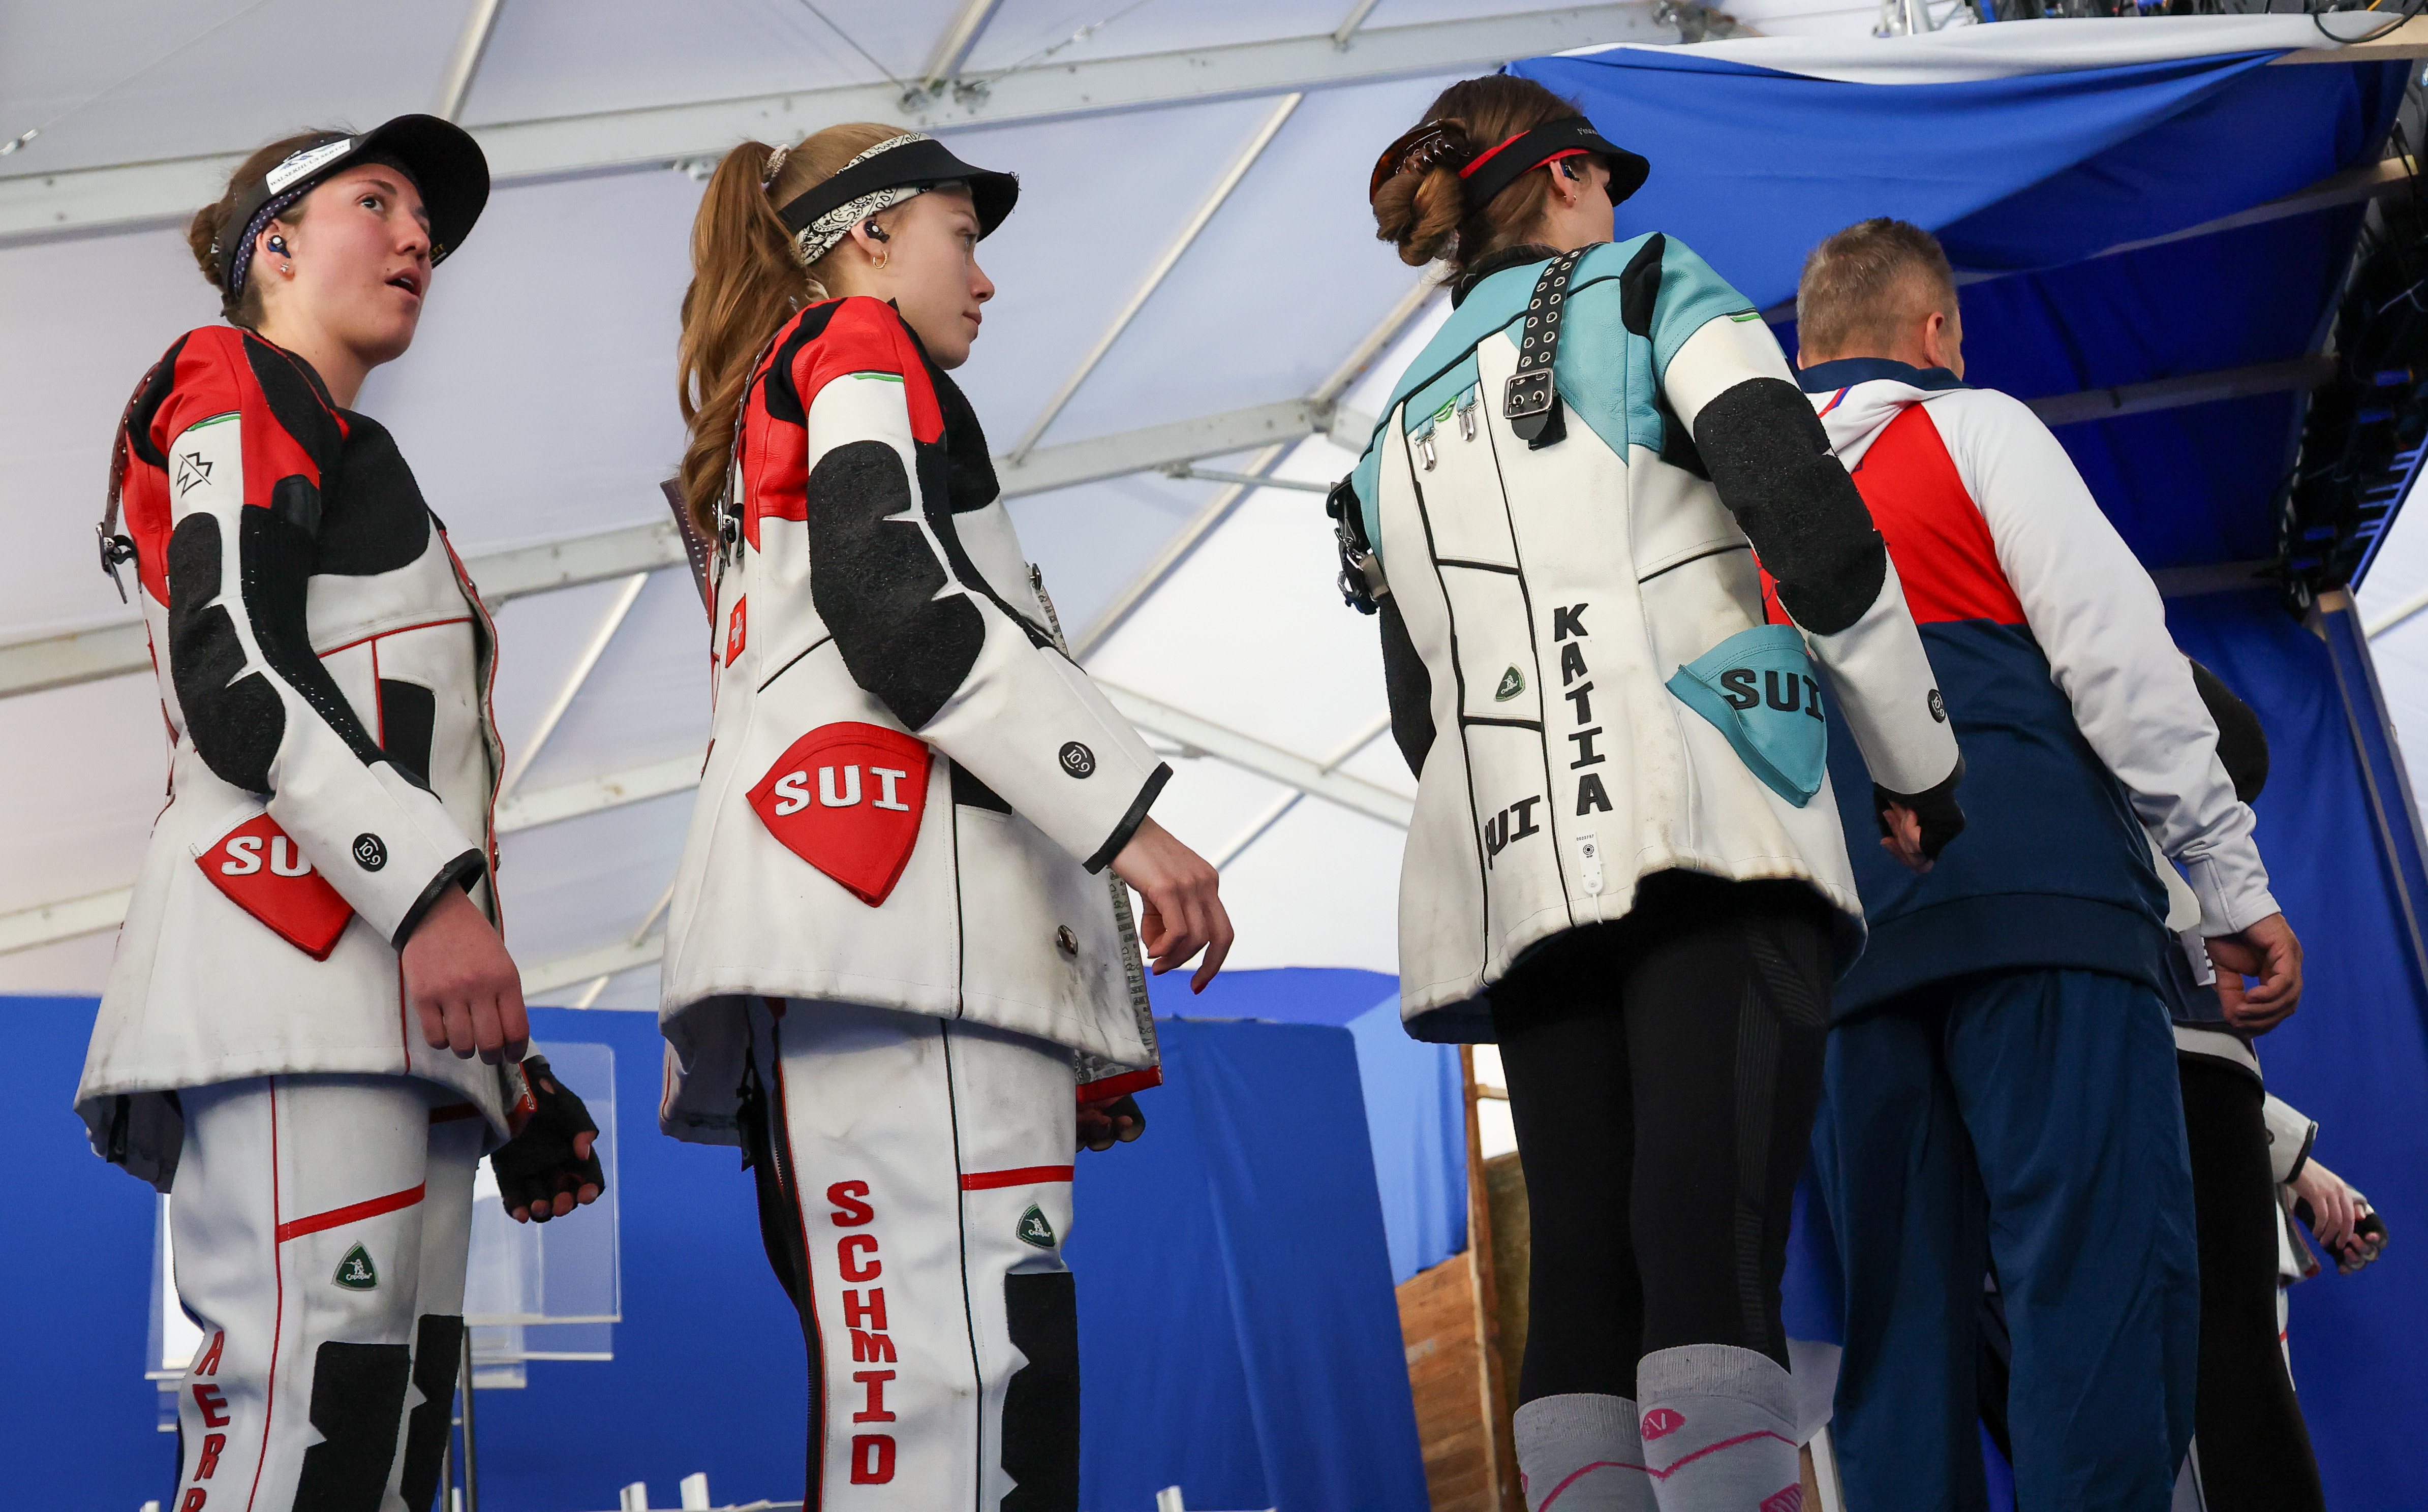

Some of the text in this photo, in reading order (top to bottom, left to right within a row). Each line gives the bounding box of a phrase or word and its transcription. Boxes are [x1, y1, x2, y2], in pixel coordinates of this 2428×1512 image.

[1554, 603, 1613, 816] KATIA
[1720, 668, 1824, 723] SUI
[1933, 696, 1945, 717] 10.9
[1066, 749, 1090, 772] 10.9
[775, 764, 910, 816] SUI
[221, 836, 317, 877] SU
[359, 841, 381, 865] 10.9
[1485, 795, 1541, 870] UI
[826, 1180, 898, 1485] SCHMID
